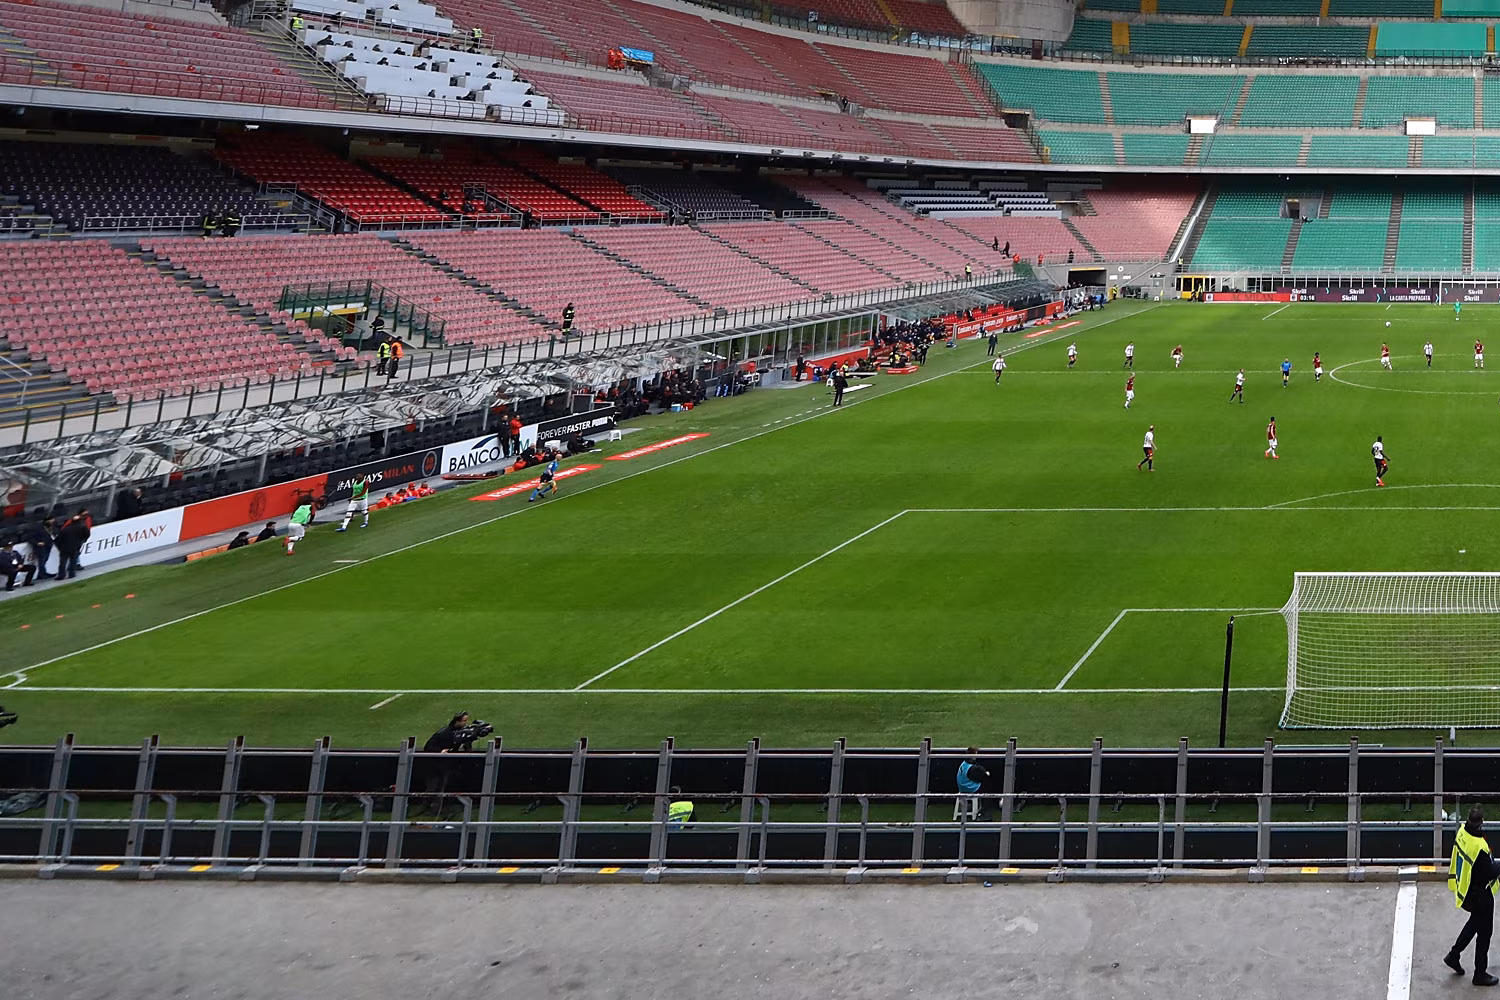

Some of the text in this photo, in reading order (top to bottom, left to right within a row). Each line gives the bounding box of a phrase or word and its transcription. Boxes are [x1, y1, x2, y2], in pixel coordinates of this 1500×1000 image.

[449, 446, 501, 472] BANCO
[97, 534, 123, 551] THE
[126, 524, 167, 544] MANY
